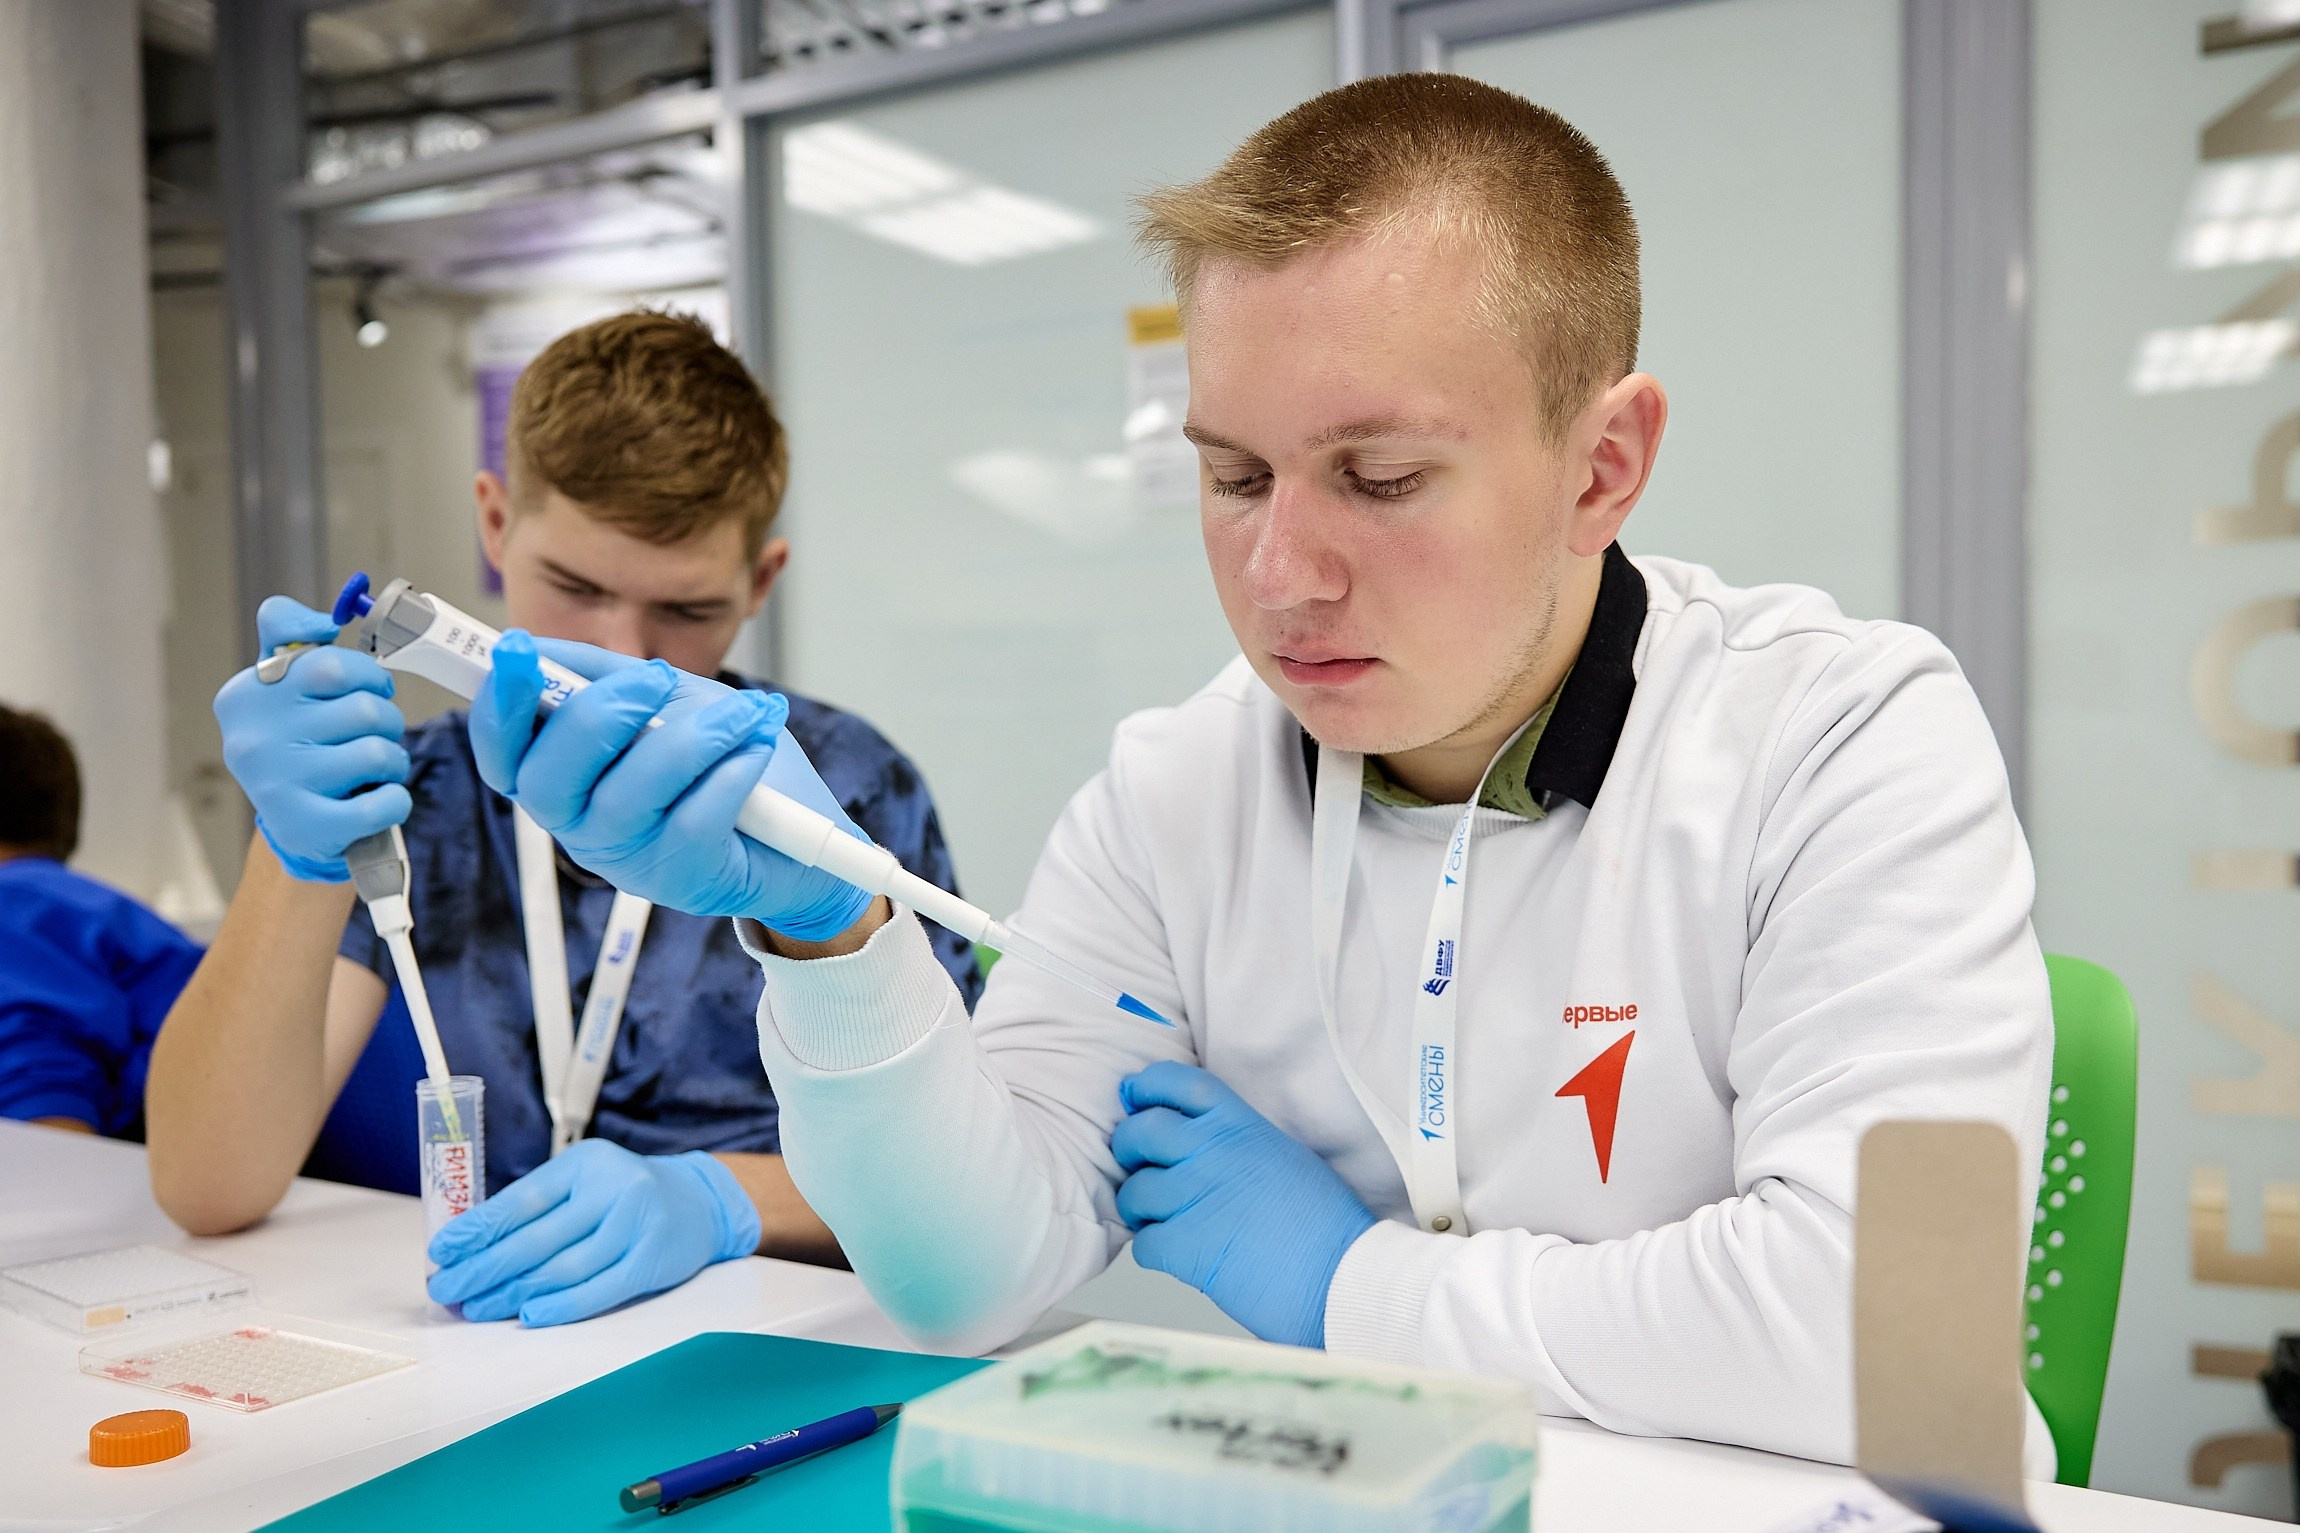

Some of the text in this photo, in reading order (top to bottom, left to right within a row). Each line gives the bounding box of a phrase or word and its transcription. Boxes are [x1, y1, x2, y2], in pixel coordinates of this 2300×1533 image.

[446, 627, 461, 645] 100
[462, 633, 480, 656] 1000
[1435, 939, 1445, 976] ДВФУ
[1562, 1004, 1638, 1029] ервые
